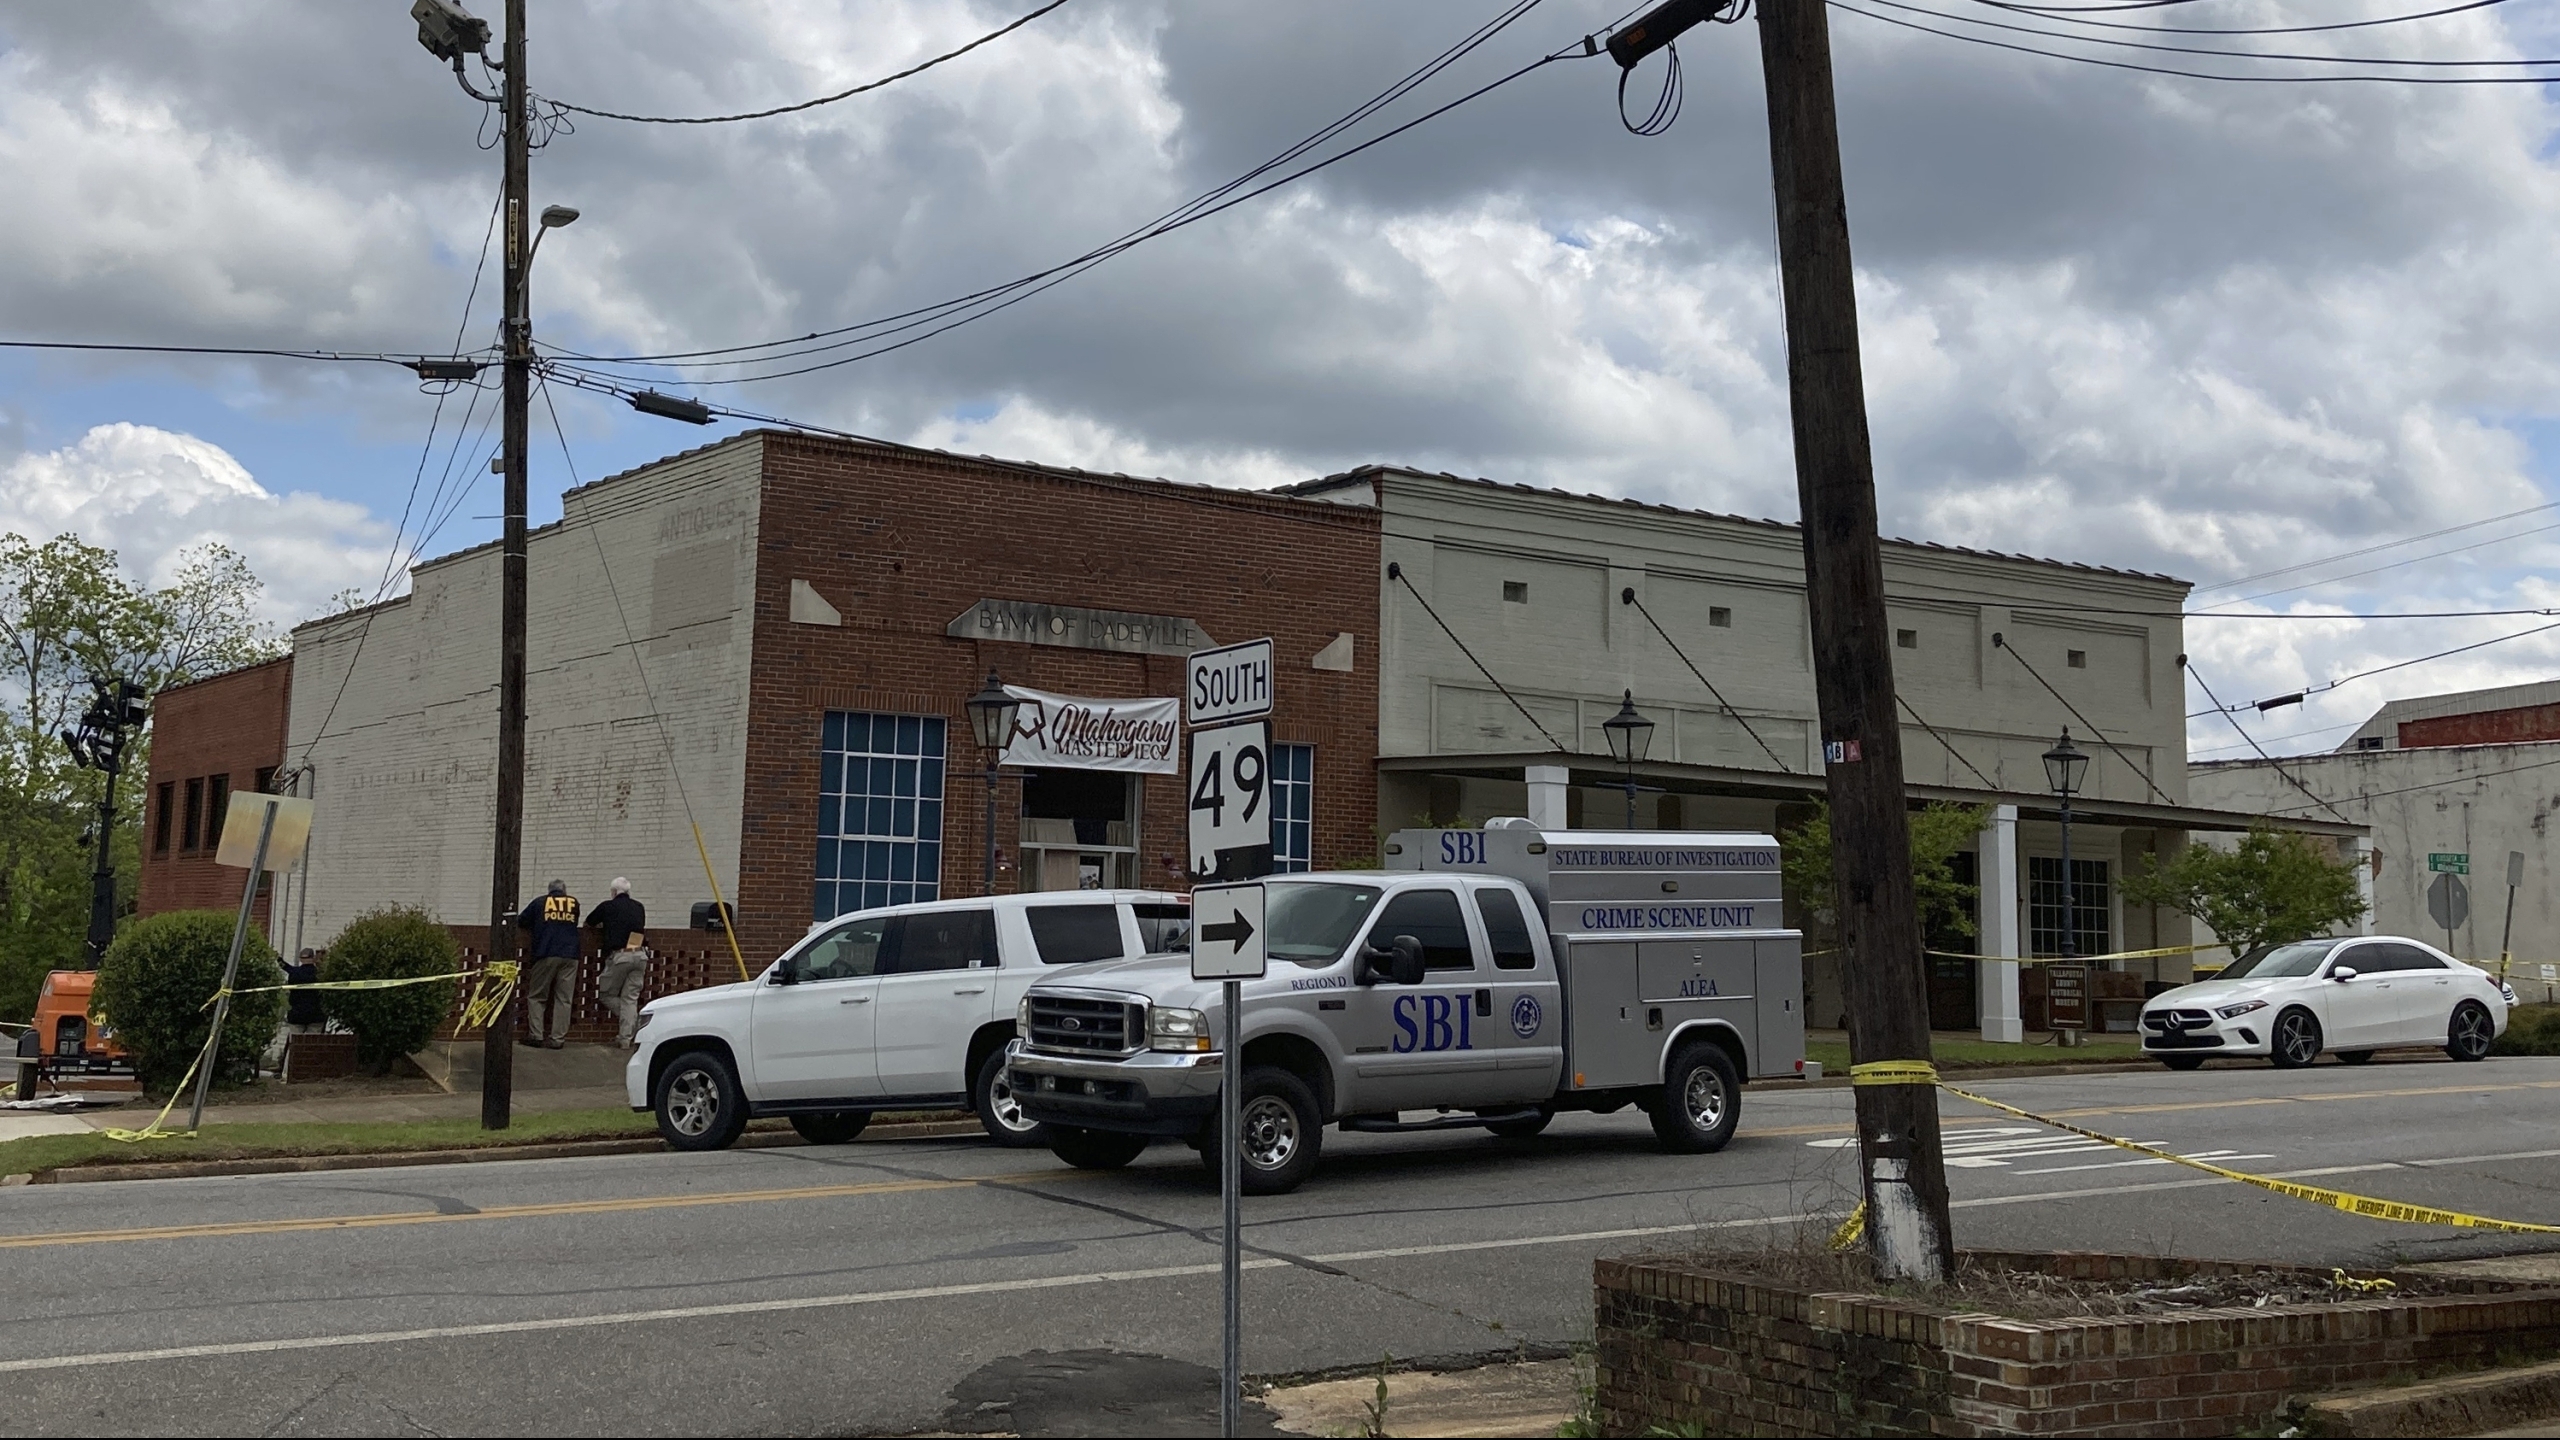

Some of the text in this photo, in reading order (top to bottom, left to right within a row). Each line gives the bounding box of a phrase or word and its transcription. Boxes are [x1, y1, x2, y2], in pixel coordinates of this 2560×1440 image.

[979, 609, 1197, 648] BANK OF DADEVILLE
[1193, 658, 1268, 711] SOUTH
[1052, 703, 1177, 757] Mahogany
[1054, 738, 1170, 761] MASTERPIECE
[1835, 745, 1841, 759] B
[1850, 744, 1857, 758] A
[1192, 744, 1266, 828] 49
[1441, 831, 1487, 865] SBI
[1555, 849, 1776, 867] STATE BUREAU OF INVESTIGATION
[544, 896, 576, 912] ATF
[544, 912, 575, 923] POLICE
[1582, 906, 1755, 929] CRIME SCENE UNIT
[1291, 976, 1347, 990] REGION D
[1679, 979, 1719, 997] ALEA
[1393, 994, 1473, 1053] SBI
[2314, 1191, 2339, 1207] CROSS
[2355, 1199, 2455, 1225] SHERIFF LINE DO NOT CROSS
